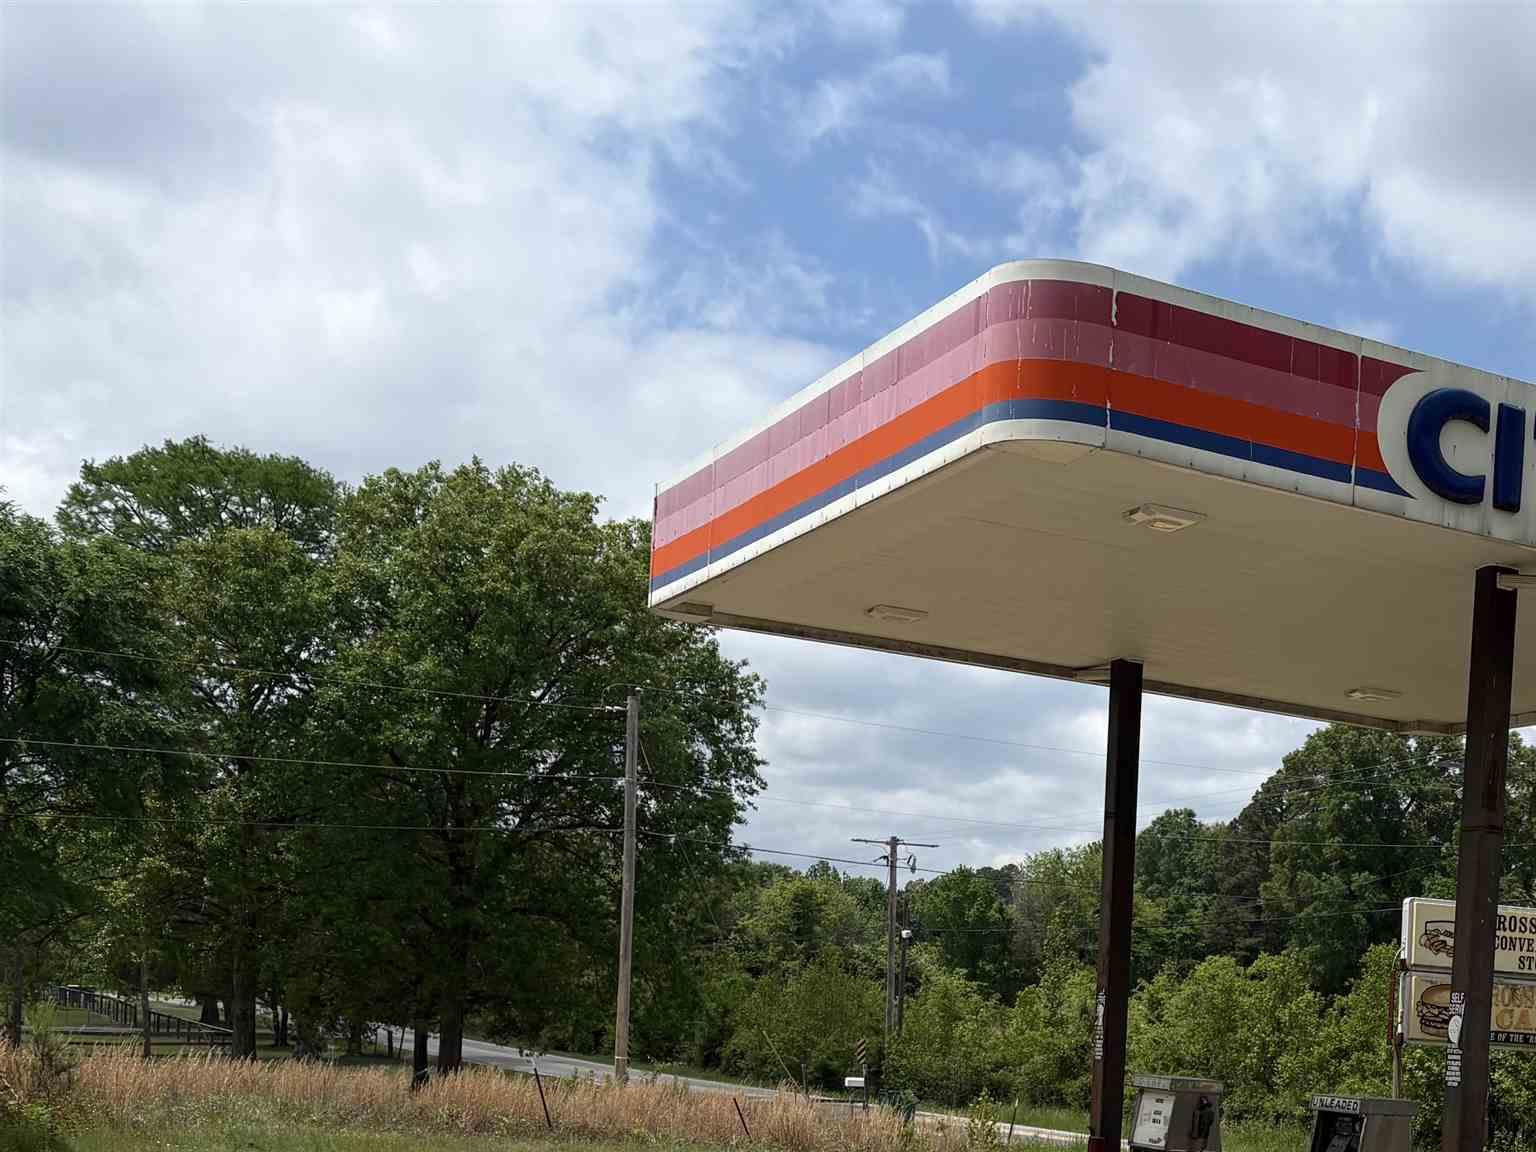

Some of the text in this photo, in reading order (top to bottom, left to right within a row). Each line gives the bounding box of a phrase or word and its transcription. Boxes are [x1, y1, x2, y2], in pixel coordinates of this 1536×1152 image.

[1497, 1032, 1508, 1042] OF
[1509, 1033, 1524, 1043] THE
[1312, 1097, 1359, 1112] UNLEADED
